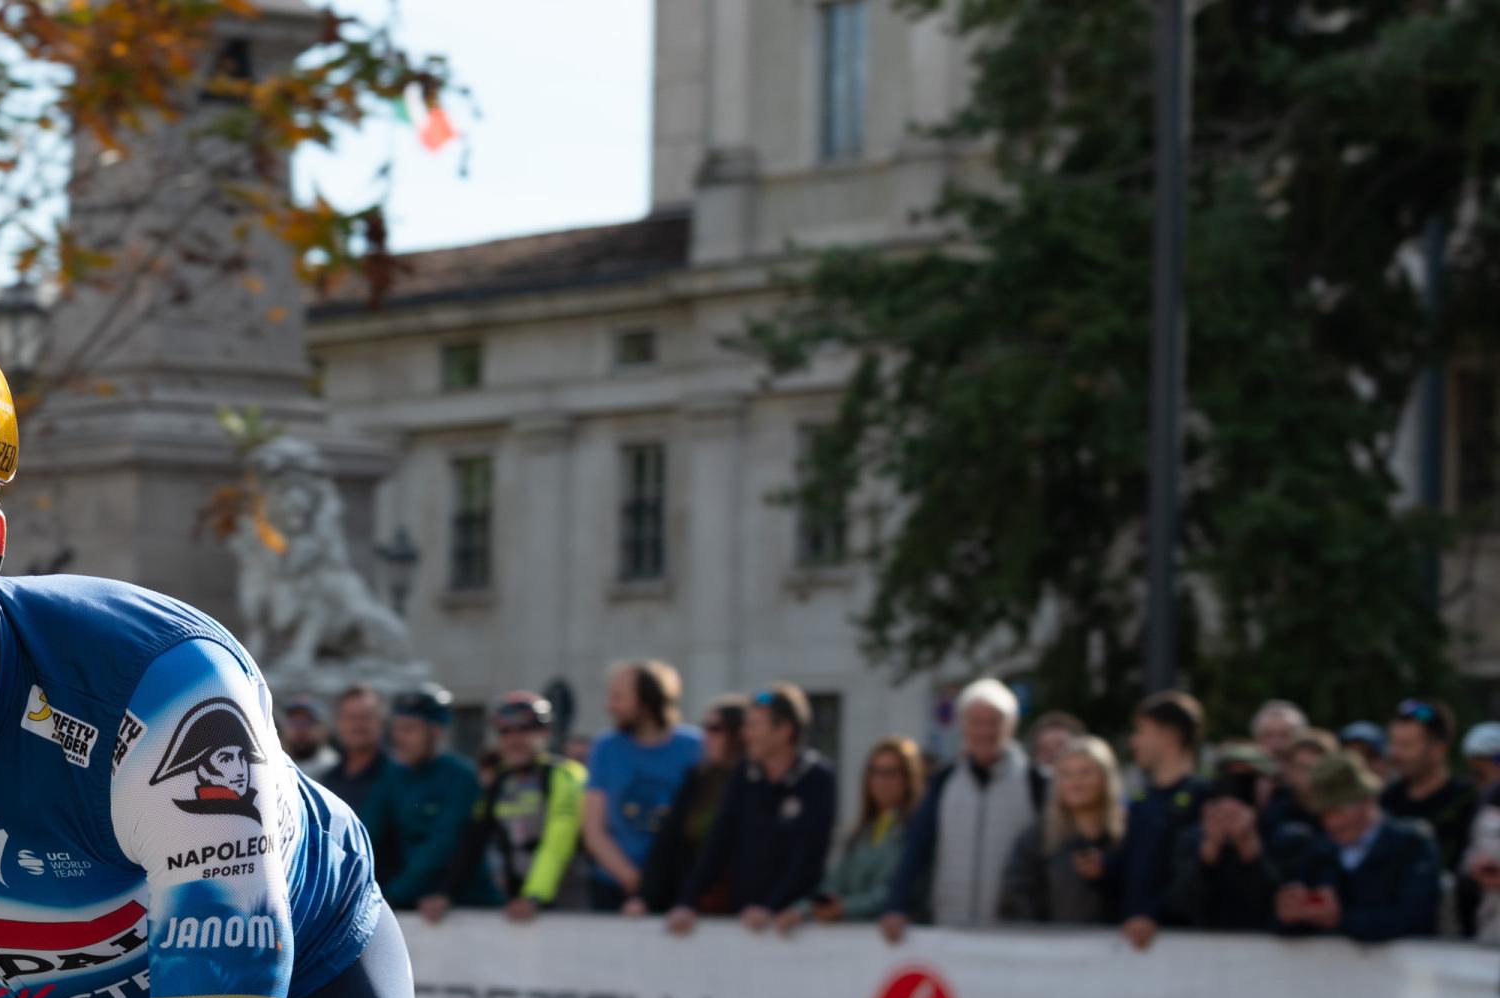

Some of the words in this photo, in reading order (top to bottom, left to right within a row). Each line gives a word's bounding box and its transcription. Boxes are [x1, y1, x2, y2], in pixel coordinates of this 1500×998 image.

[52, 711, 96, 742] AFETY
[46, 852, 71, 861] UCI
[166, 834, 275, 870] NAPOLEON
[49, 861, 92, 870] WORLD
[202, 863, 255, 879] SPORTS
[52, 869, 86, 878] TEAM
